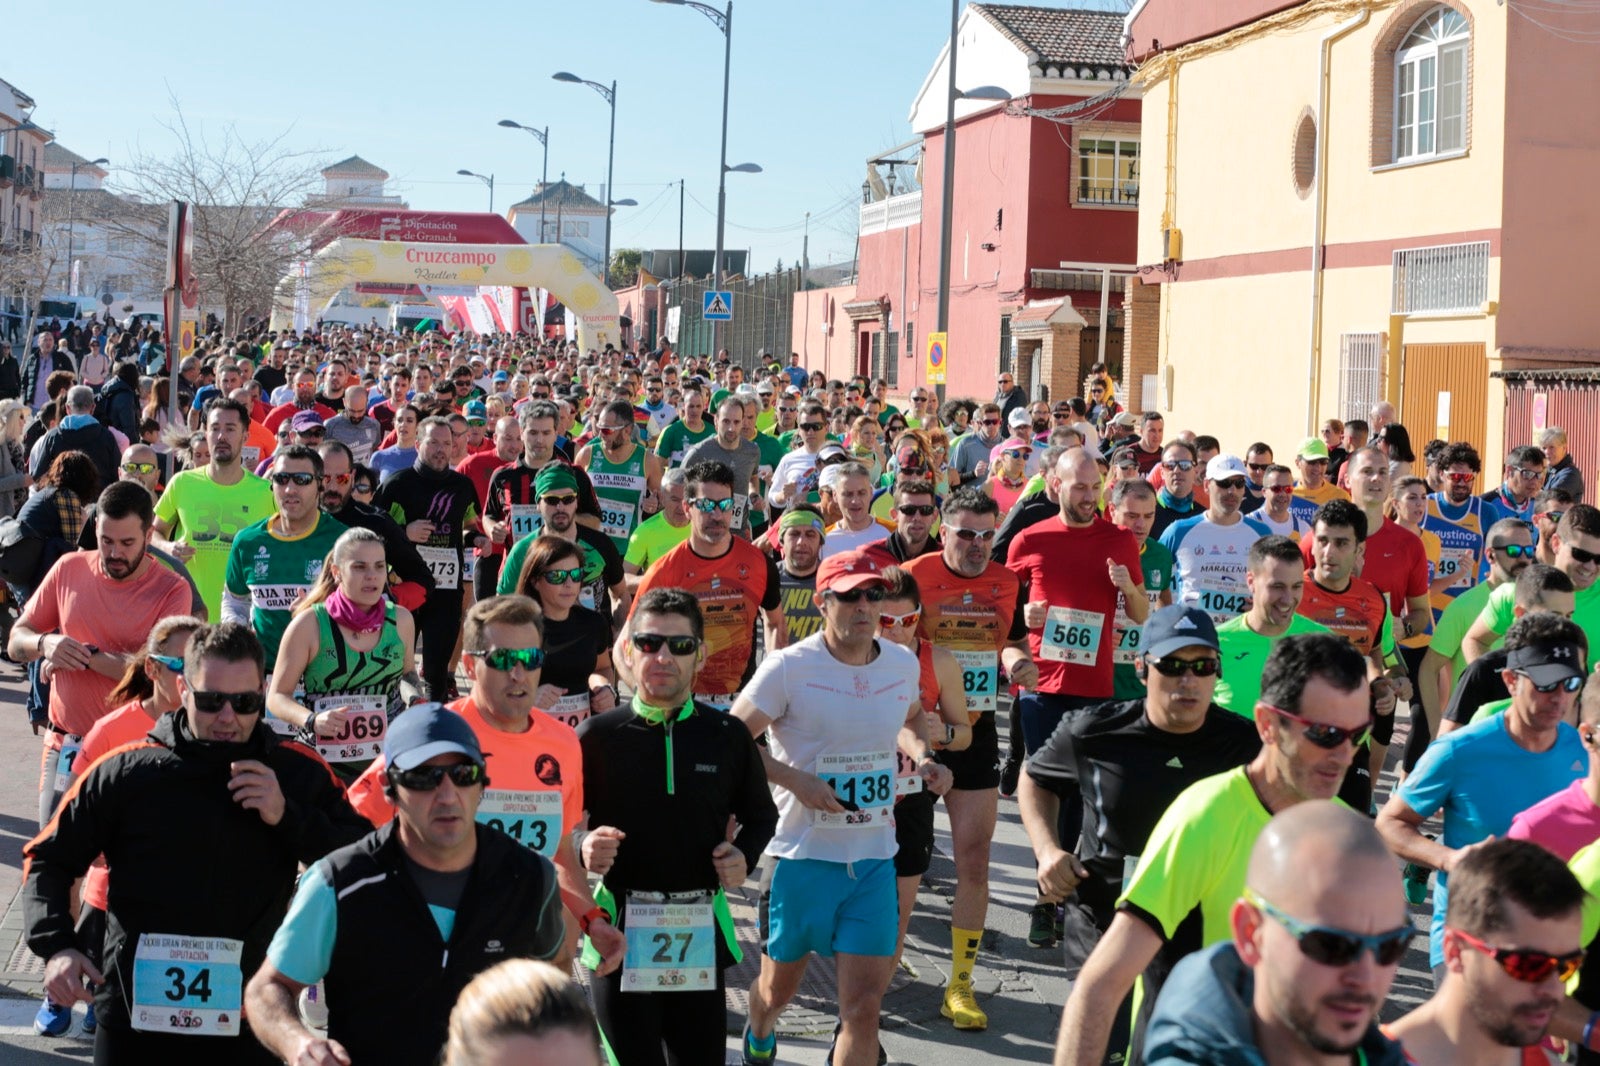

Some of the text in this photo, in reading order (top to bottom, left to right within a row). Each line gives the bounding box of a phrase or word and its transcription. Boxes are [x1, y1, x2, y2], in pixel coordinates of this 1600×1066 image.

[405, 219, 457, 230] Diputación
[404, 231, 457, 241] de Granada
[406, 248, 497, 267] Cruzcampo
[414, 267, 458, 281] Radler
[613, 475, 636, 484] RURAL
[601, 510, 626, 527] 693
[1200, 565, 1248, 574] MARACENA
[1202, 592, 1246, 613] 1042
[1053, 624, 1091, 647] 566
[839, 755, 852, 763] GRAN
[496, 792, 512, 801] GRAN
[514, 793, 535, 803] PREMIO
[535, 794, 542, 803] DE
[543, 793, 559, 803] FONDO
[649, 907, 664, 916] GRAN
[666, 907, 686, 916] PREMIO
[687, 907, 694, 915] DE
[162, 939, 179, 948] GRAN
[181, 940, 204, 950] PREMIO
[205, 941, 213, 950] DE
[216, 941, 237, 951] FONDO
[652, 932, 693, 962] 27
[165, 966, 212, 1003] 34
